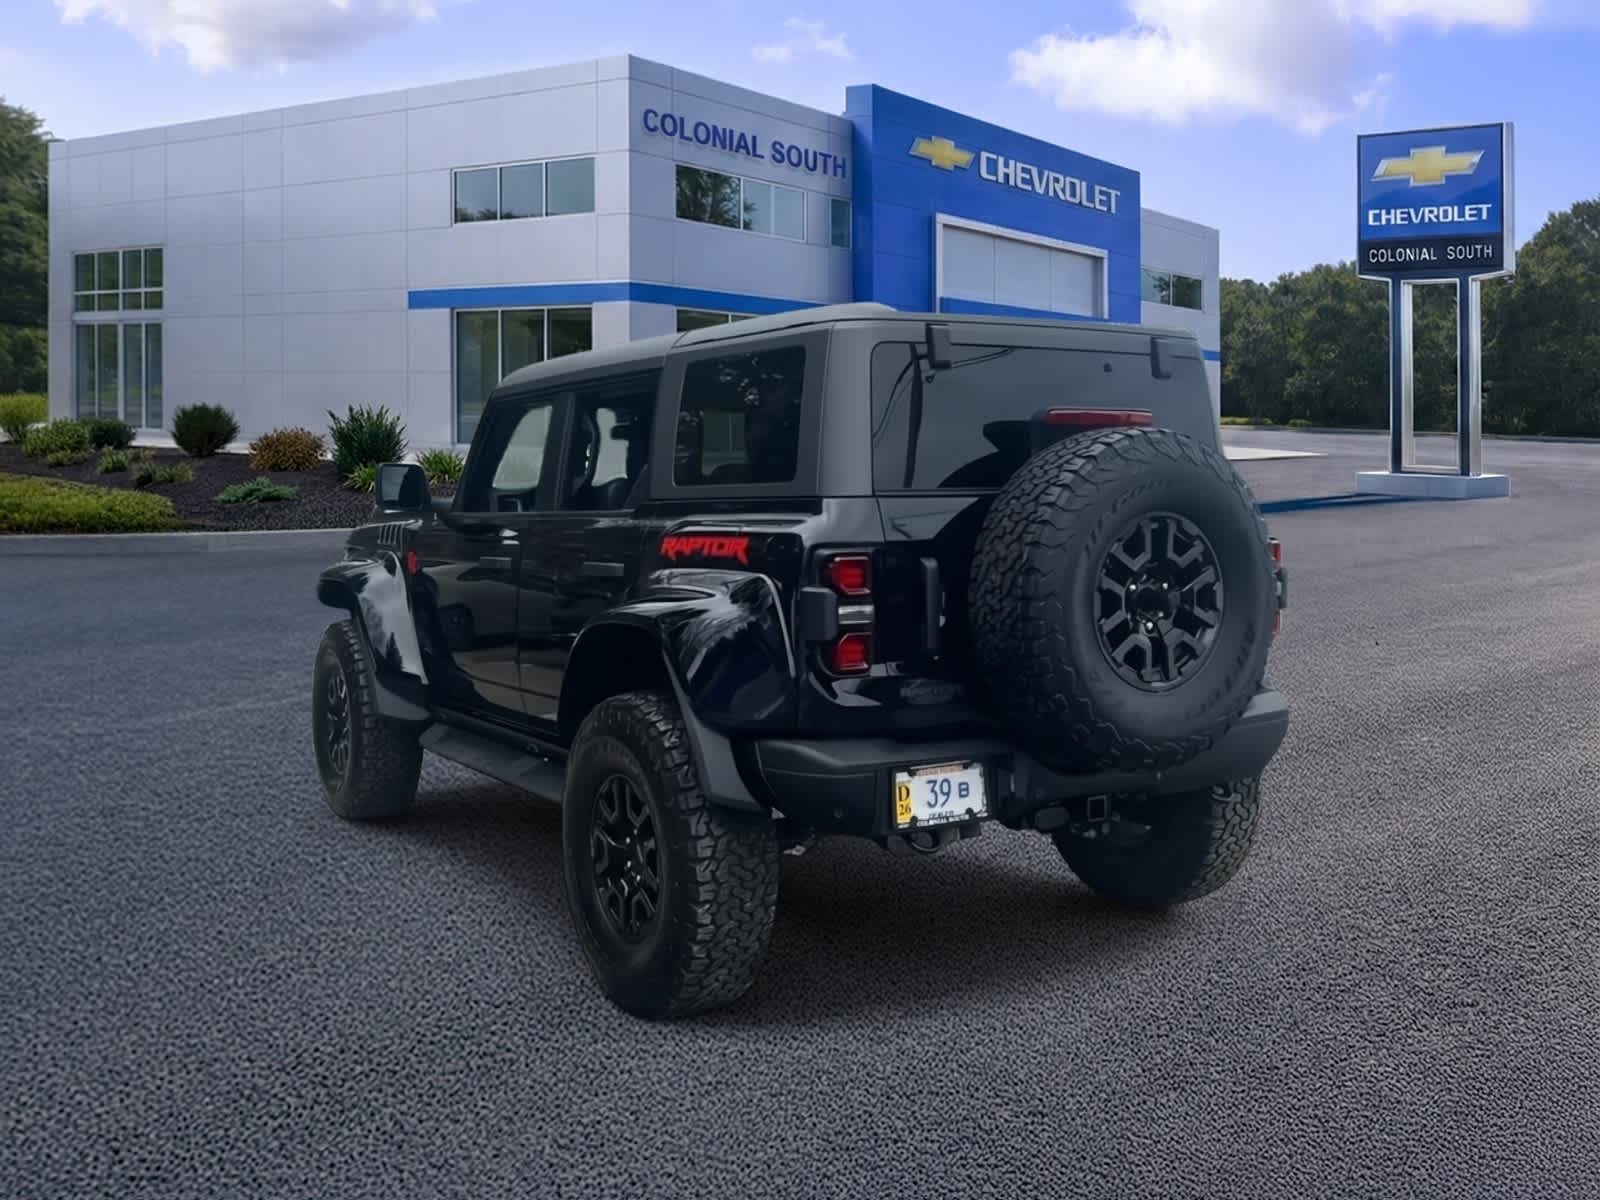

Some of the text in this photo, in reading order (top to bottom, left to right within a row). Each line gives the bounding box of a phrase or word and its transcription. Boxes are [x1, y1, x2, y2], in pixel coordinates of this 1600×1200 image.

[643, 108, 847, 179] COLONIAL SOUTH
[979, 150, 1121, 214] CHEVROLET
[1367, 203, 1492, 226] CHEVROLET
[1369, 244, 1493, 263] COLONIAL SOUTH
[659, 535, 750, 565] RAPTOR
[898, 784, 910, 802] D
[926, 778, 951, 808] 39
